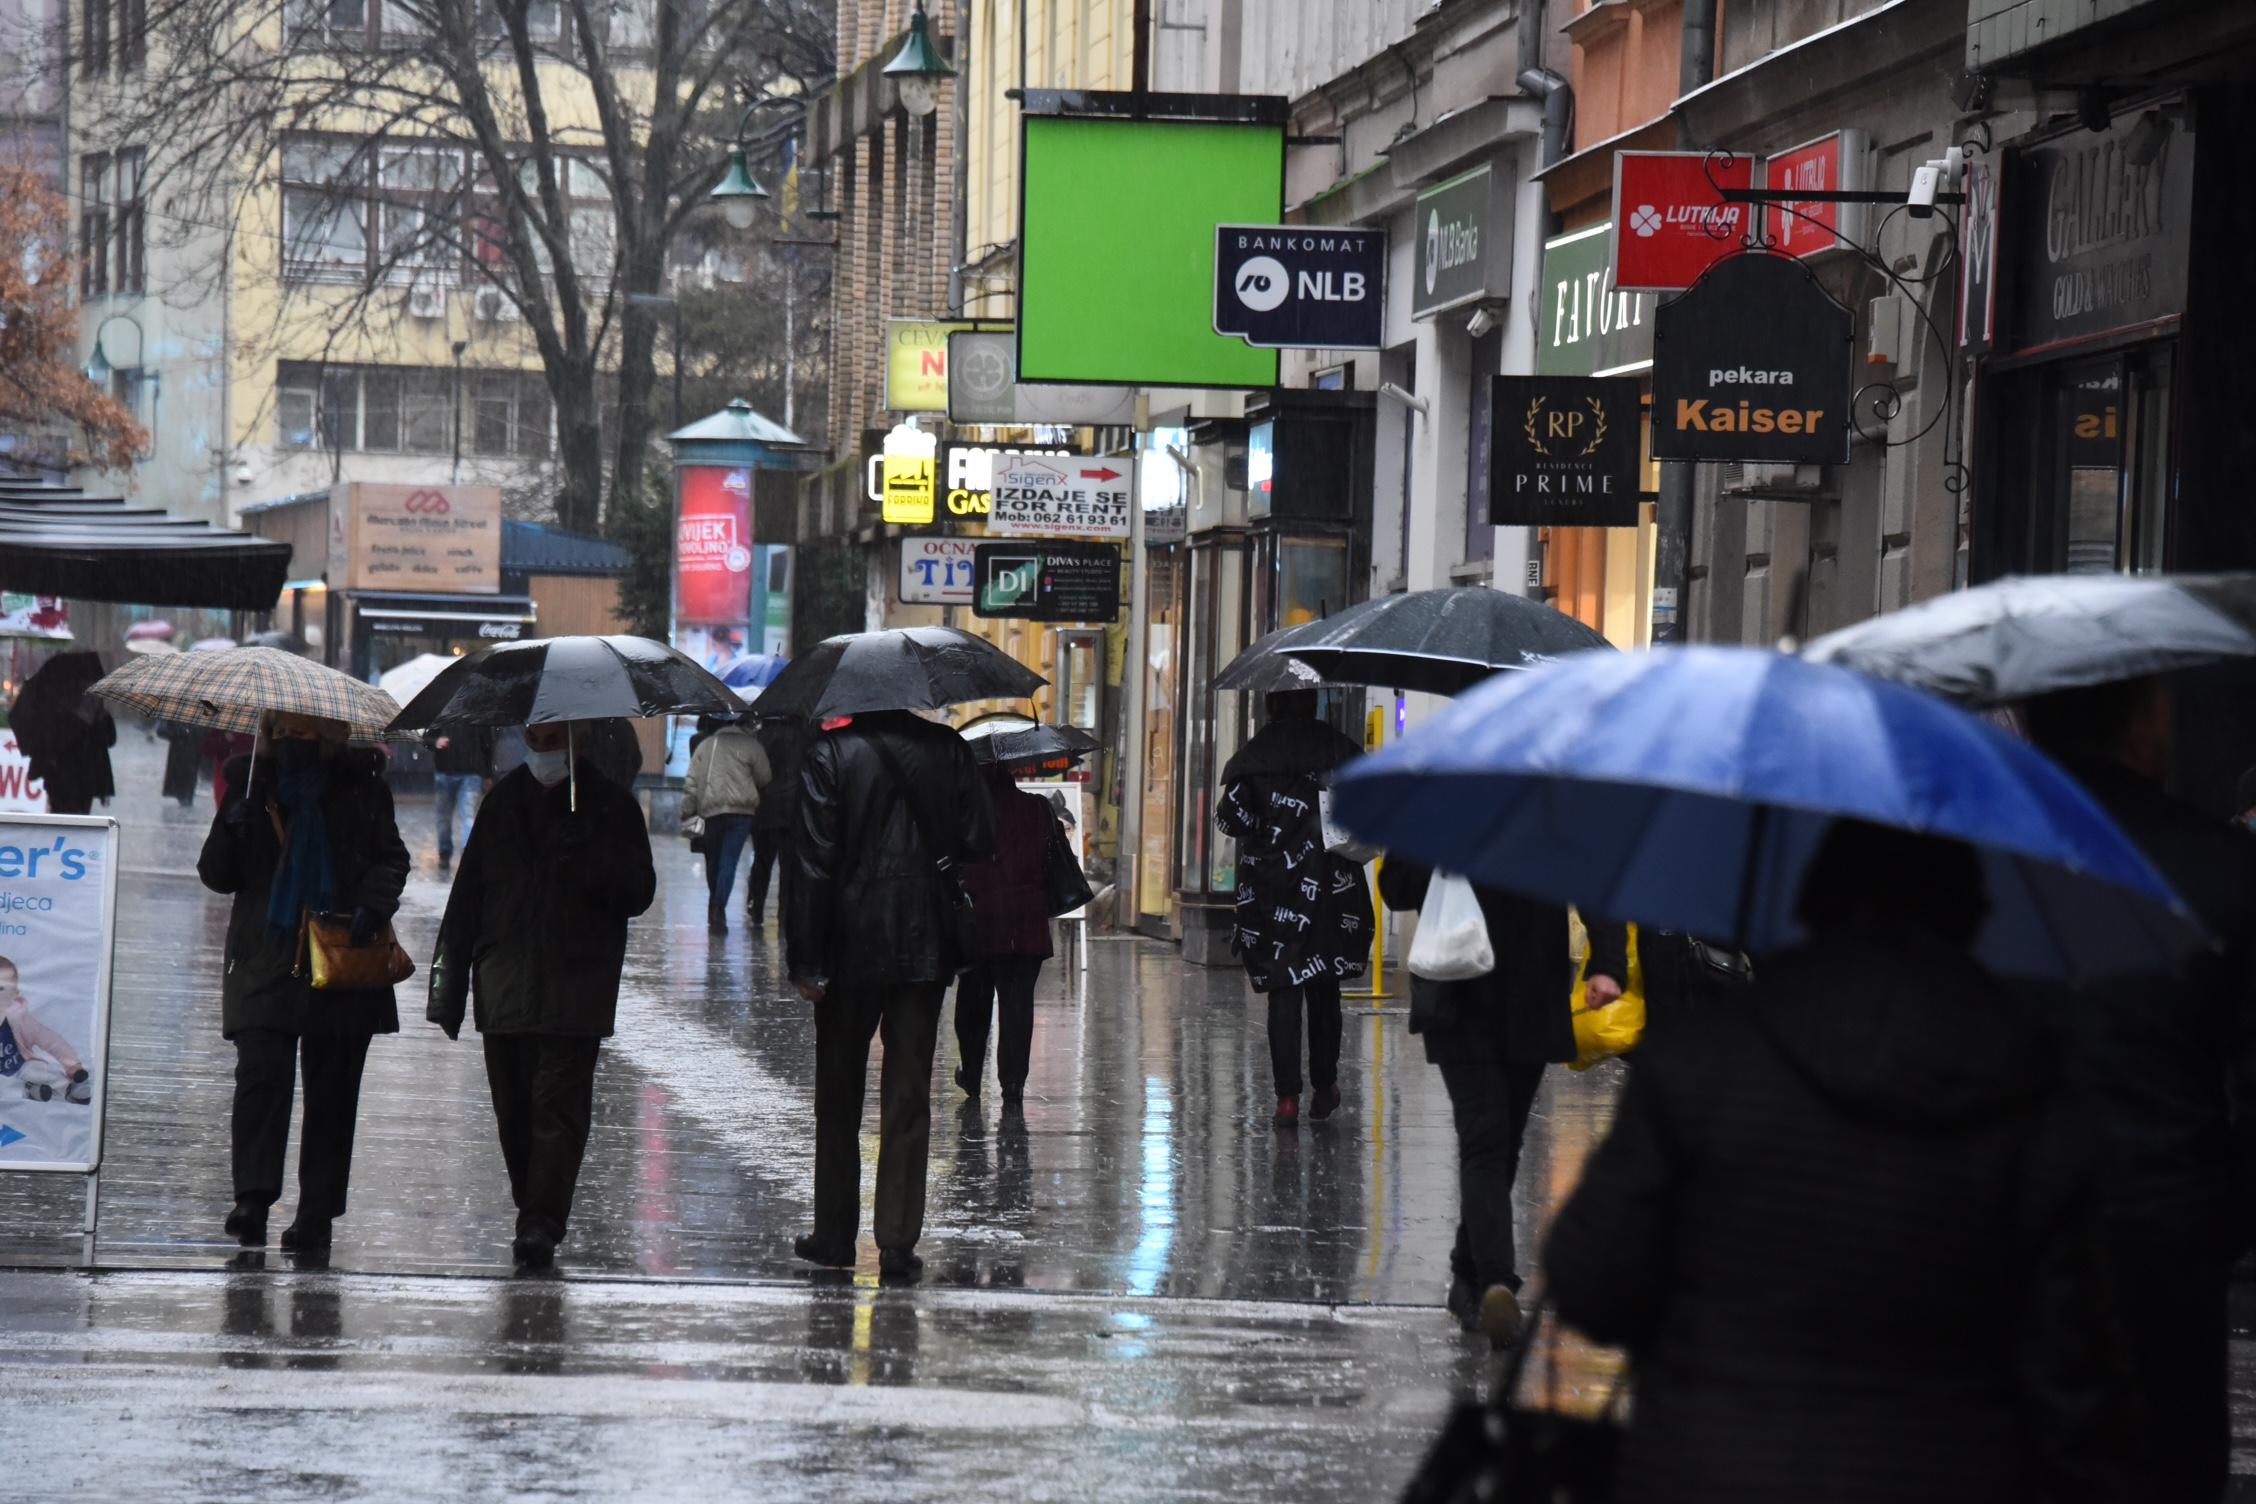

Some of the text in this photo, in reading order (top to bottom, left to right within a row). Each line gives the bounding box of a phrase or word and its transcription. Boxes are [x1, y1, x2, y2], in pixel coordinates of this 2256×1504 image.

[1666, 205, 1740, 225] LUTRIJA
[1238, 235, 1366, 253] BANKOMAT
[1454, 212, 1478, 266] Banka
[1298, 270, 1367, 302] NLB
[2054, 271, 2083, 320] GOLD
[2097, 253, 2153, 310] WATCHES
[1709, 366, 1794, 388] pekara
[1548, 411, 1584, 438] RP
[1676, 399, 1825, 434] Kaiser
[1516, 474, 1613, 493] PRIME
[996, 488, 1127, 504] IZDAJE SE
[996, 500, 1127, 514] FOR RENT
[995, 511, 1127, 526] Mob: 062 61 93 61
[1010, 522, 1112, 532] www.sigenx.com
[1083, 559, 1112, 567] PLACE
[1000, 570, 1027, 592] DI
[1288, 954, 1327, 985] Laili
